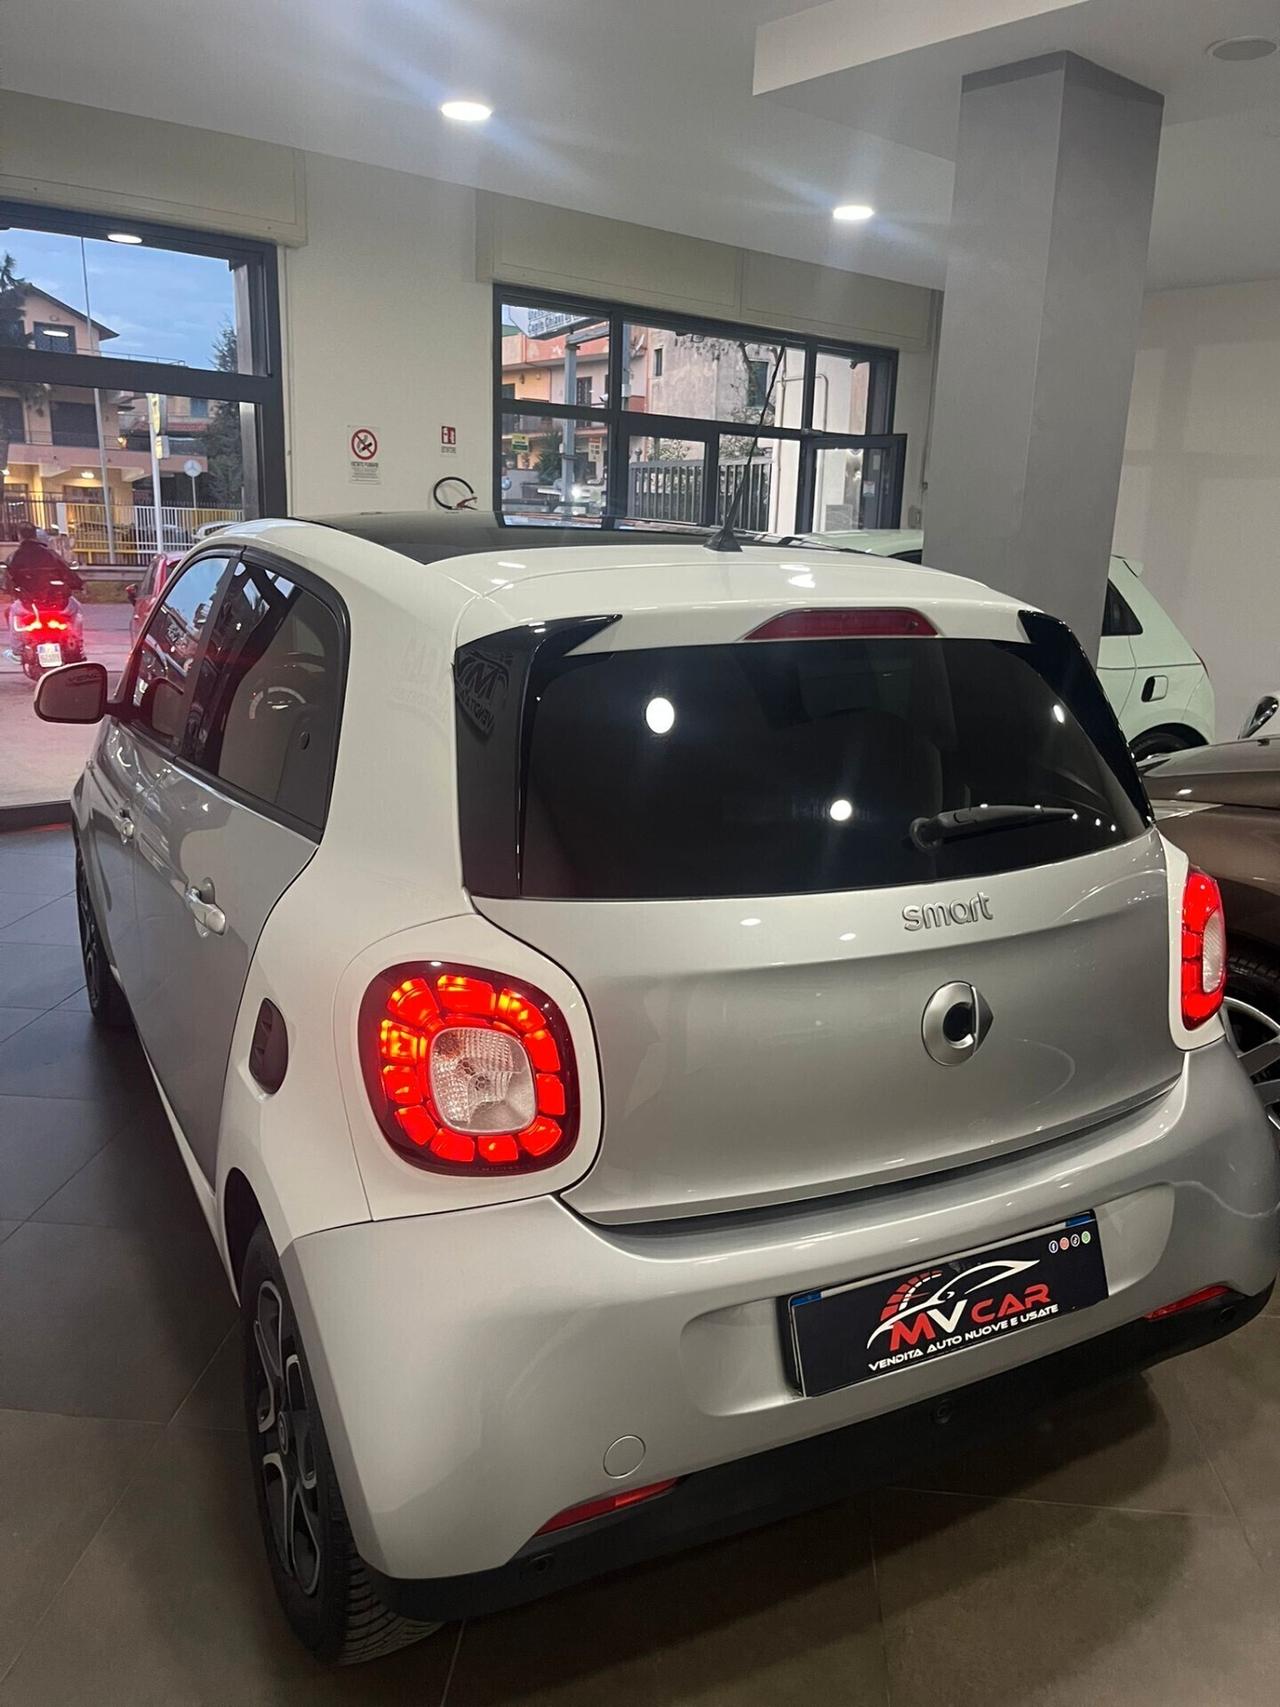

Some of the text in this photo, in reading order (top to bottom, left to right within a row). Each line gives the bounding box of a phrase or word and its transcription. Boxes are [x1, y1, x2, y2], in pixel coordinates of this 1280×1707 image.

[902, 892, 993, 931] smart
[868, 1303, 1059, 1371] VENDITA AUTO NUOVE E USATE
[890, 1283, 1051, 1351] MV CAR
